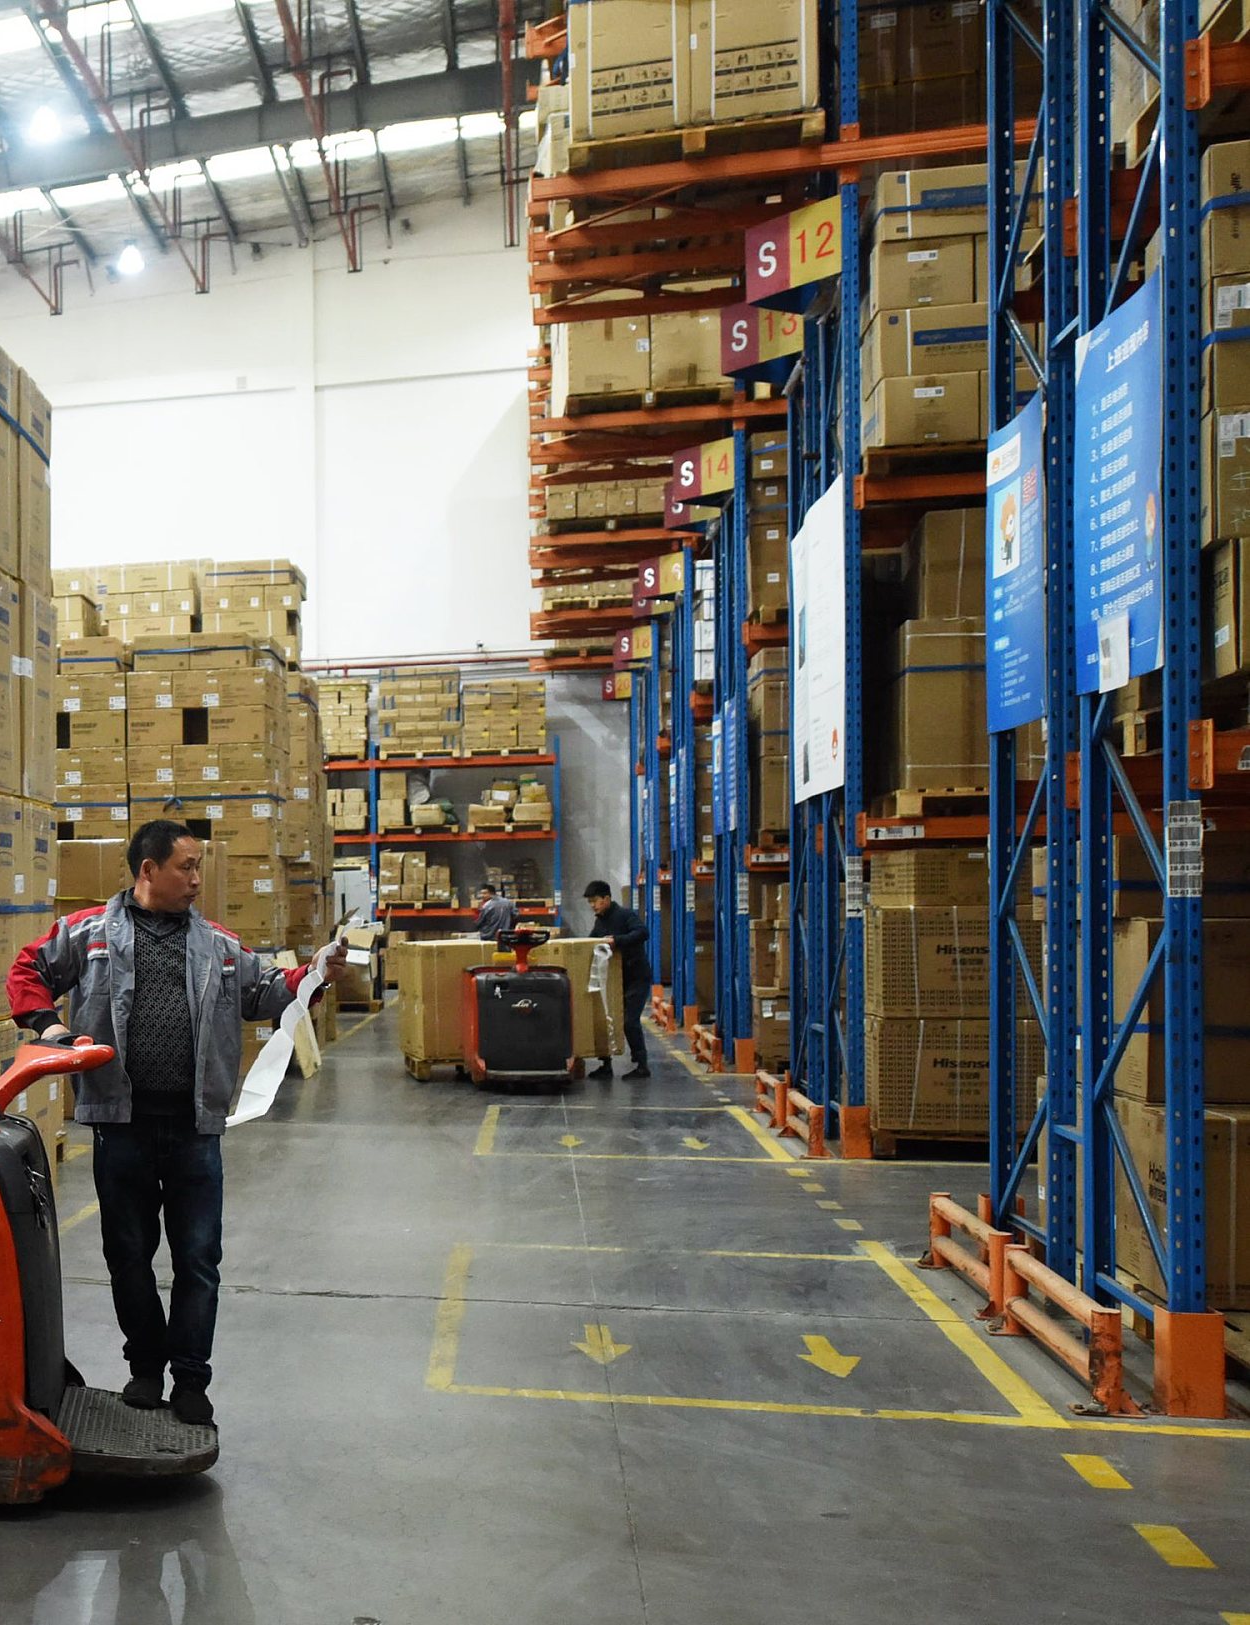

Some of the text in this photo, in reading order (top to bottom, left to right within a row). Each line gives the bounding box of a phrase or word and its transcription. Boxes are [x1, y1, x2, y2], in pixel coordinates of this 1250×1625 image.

[758, 221, 835, 278] S 12
[731, 311, 798, 351] S 13
[680, 452, 730, 487] S 14
[643, 567, 655, 588] S
[620, 636, 630, 653] S
[605, 678, 631, 693] S 20
[936, 944, 990, 955] Hisens
[1149, 1160, 1167, 1186] Haie
